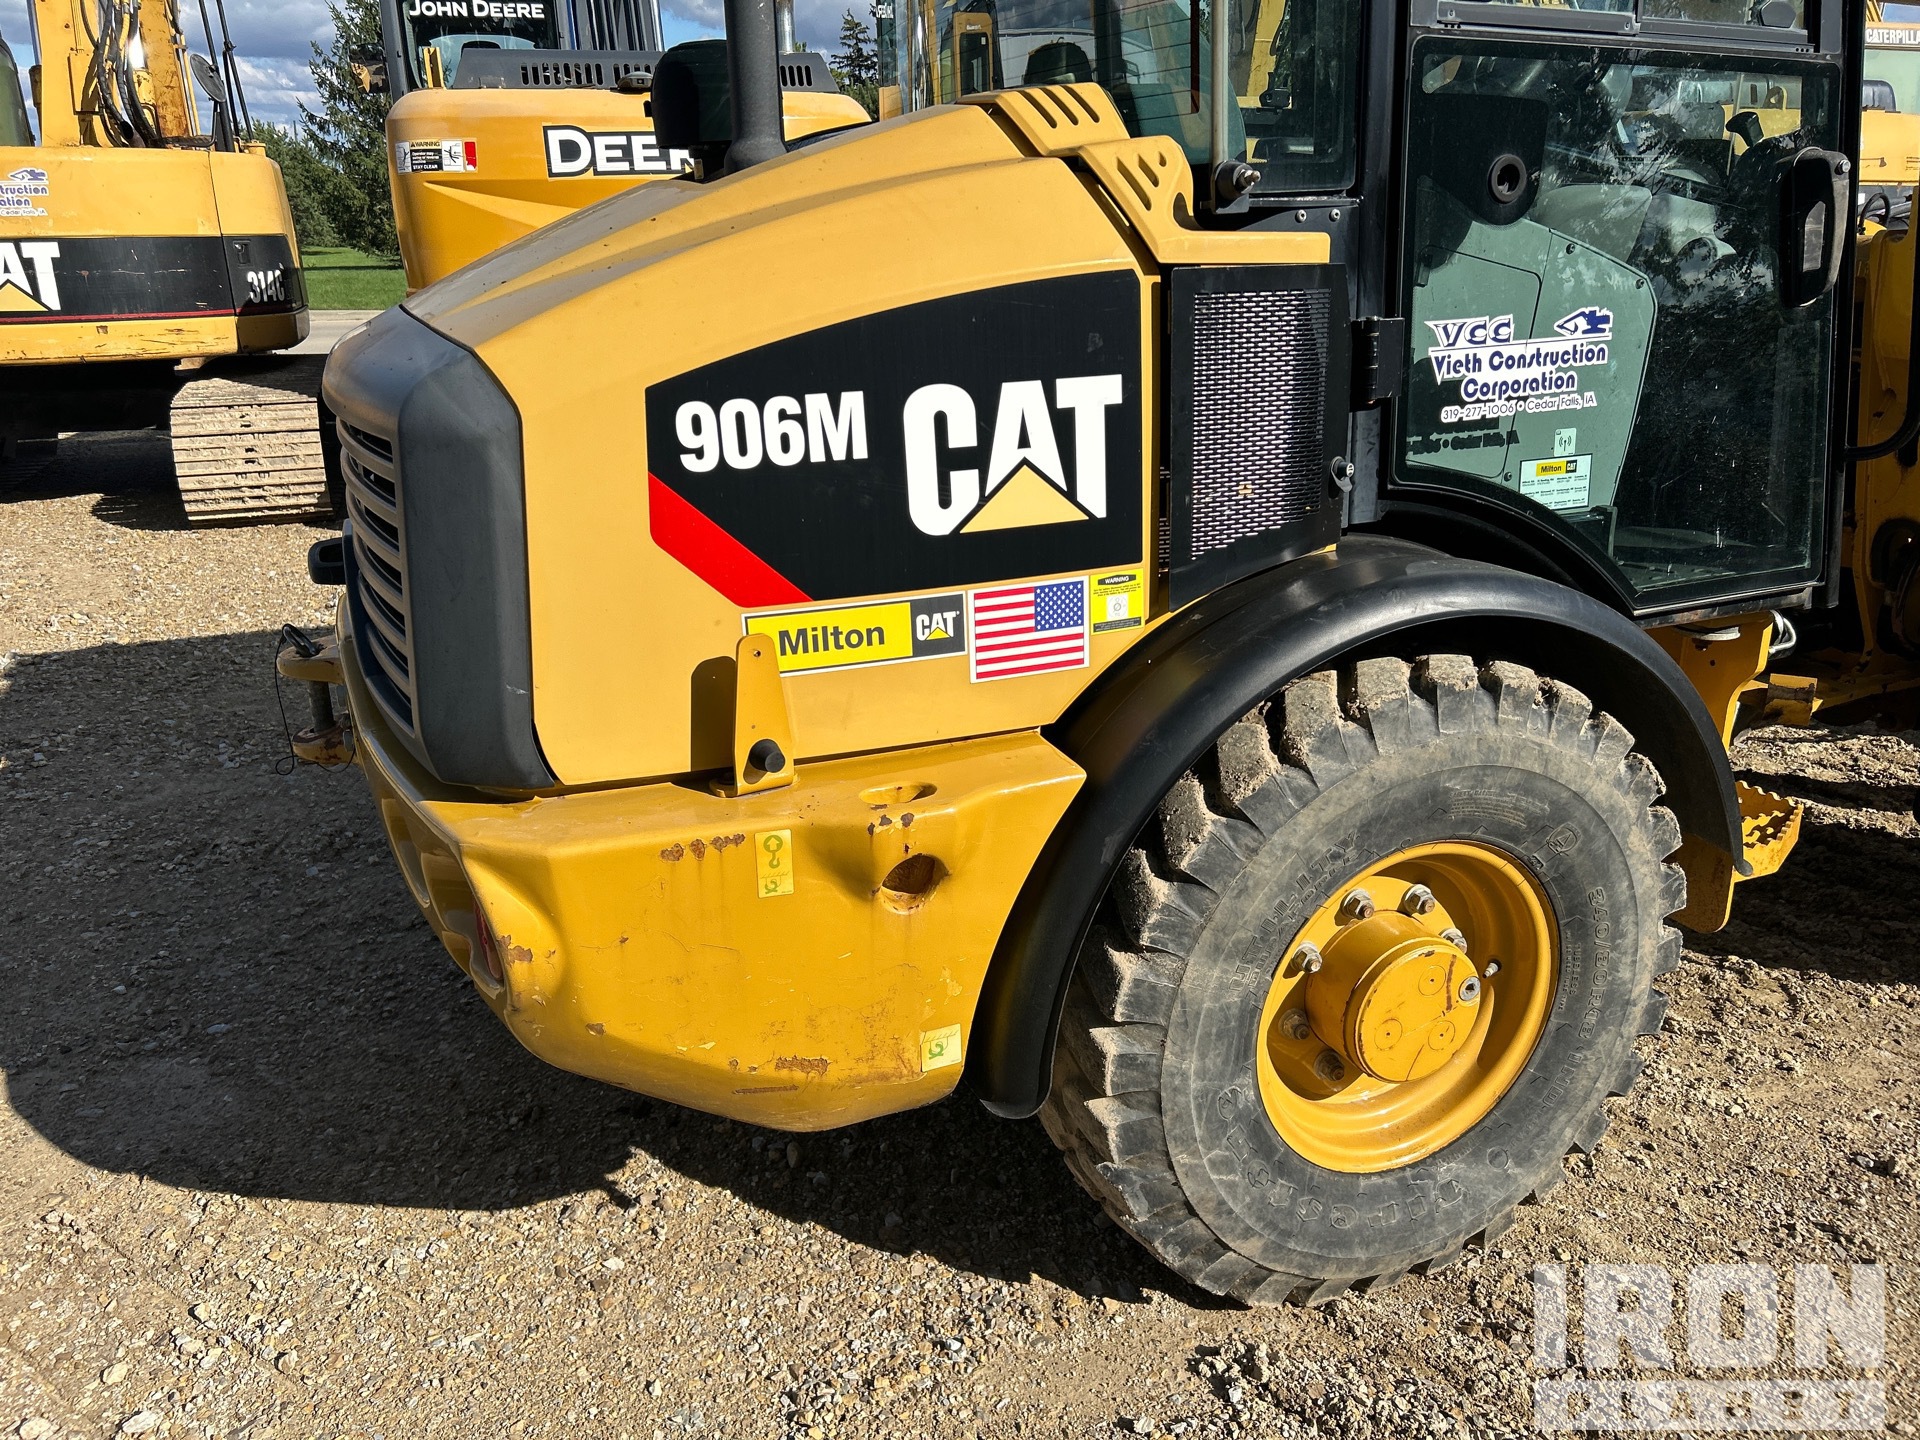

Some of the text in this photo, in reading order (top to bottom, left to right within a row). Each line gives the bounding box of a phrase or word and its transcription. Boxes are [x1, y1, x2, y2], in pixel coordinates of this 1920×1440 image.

[409, 0, 545, 18] JOHN DEERE
[247, 269, 286, 303] 314C
[1430, 316, 1513, 348] VCC
[1434, 342, 1607, 376] Vieth Construction
[1462, 370, 1576, 401] Corporation
[1442, 402, 1515, 420] 319-277-1006
[1527, 397, 1557, 411] Cedar
[1584, 394, 1595, 406] IA
[675, 390, 869, 473] 906M
[903, 374, 1123, 536] CAT
[1540, 462, 1577, 474] Milton CAT
[1104, 575, 1130, 585] WARNING
[778, 610, 960, 657] Milton CAT
[1578, 886, 1612, 1039] 340/80R18
